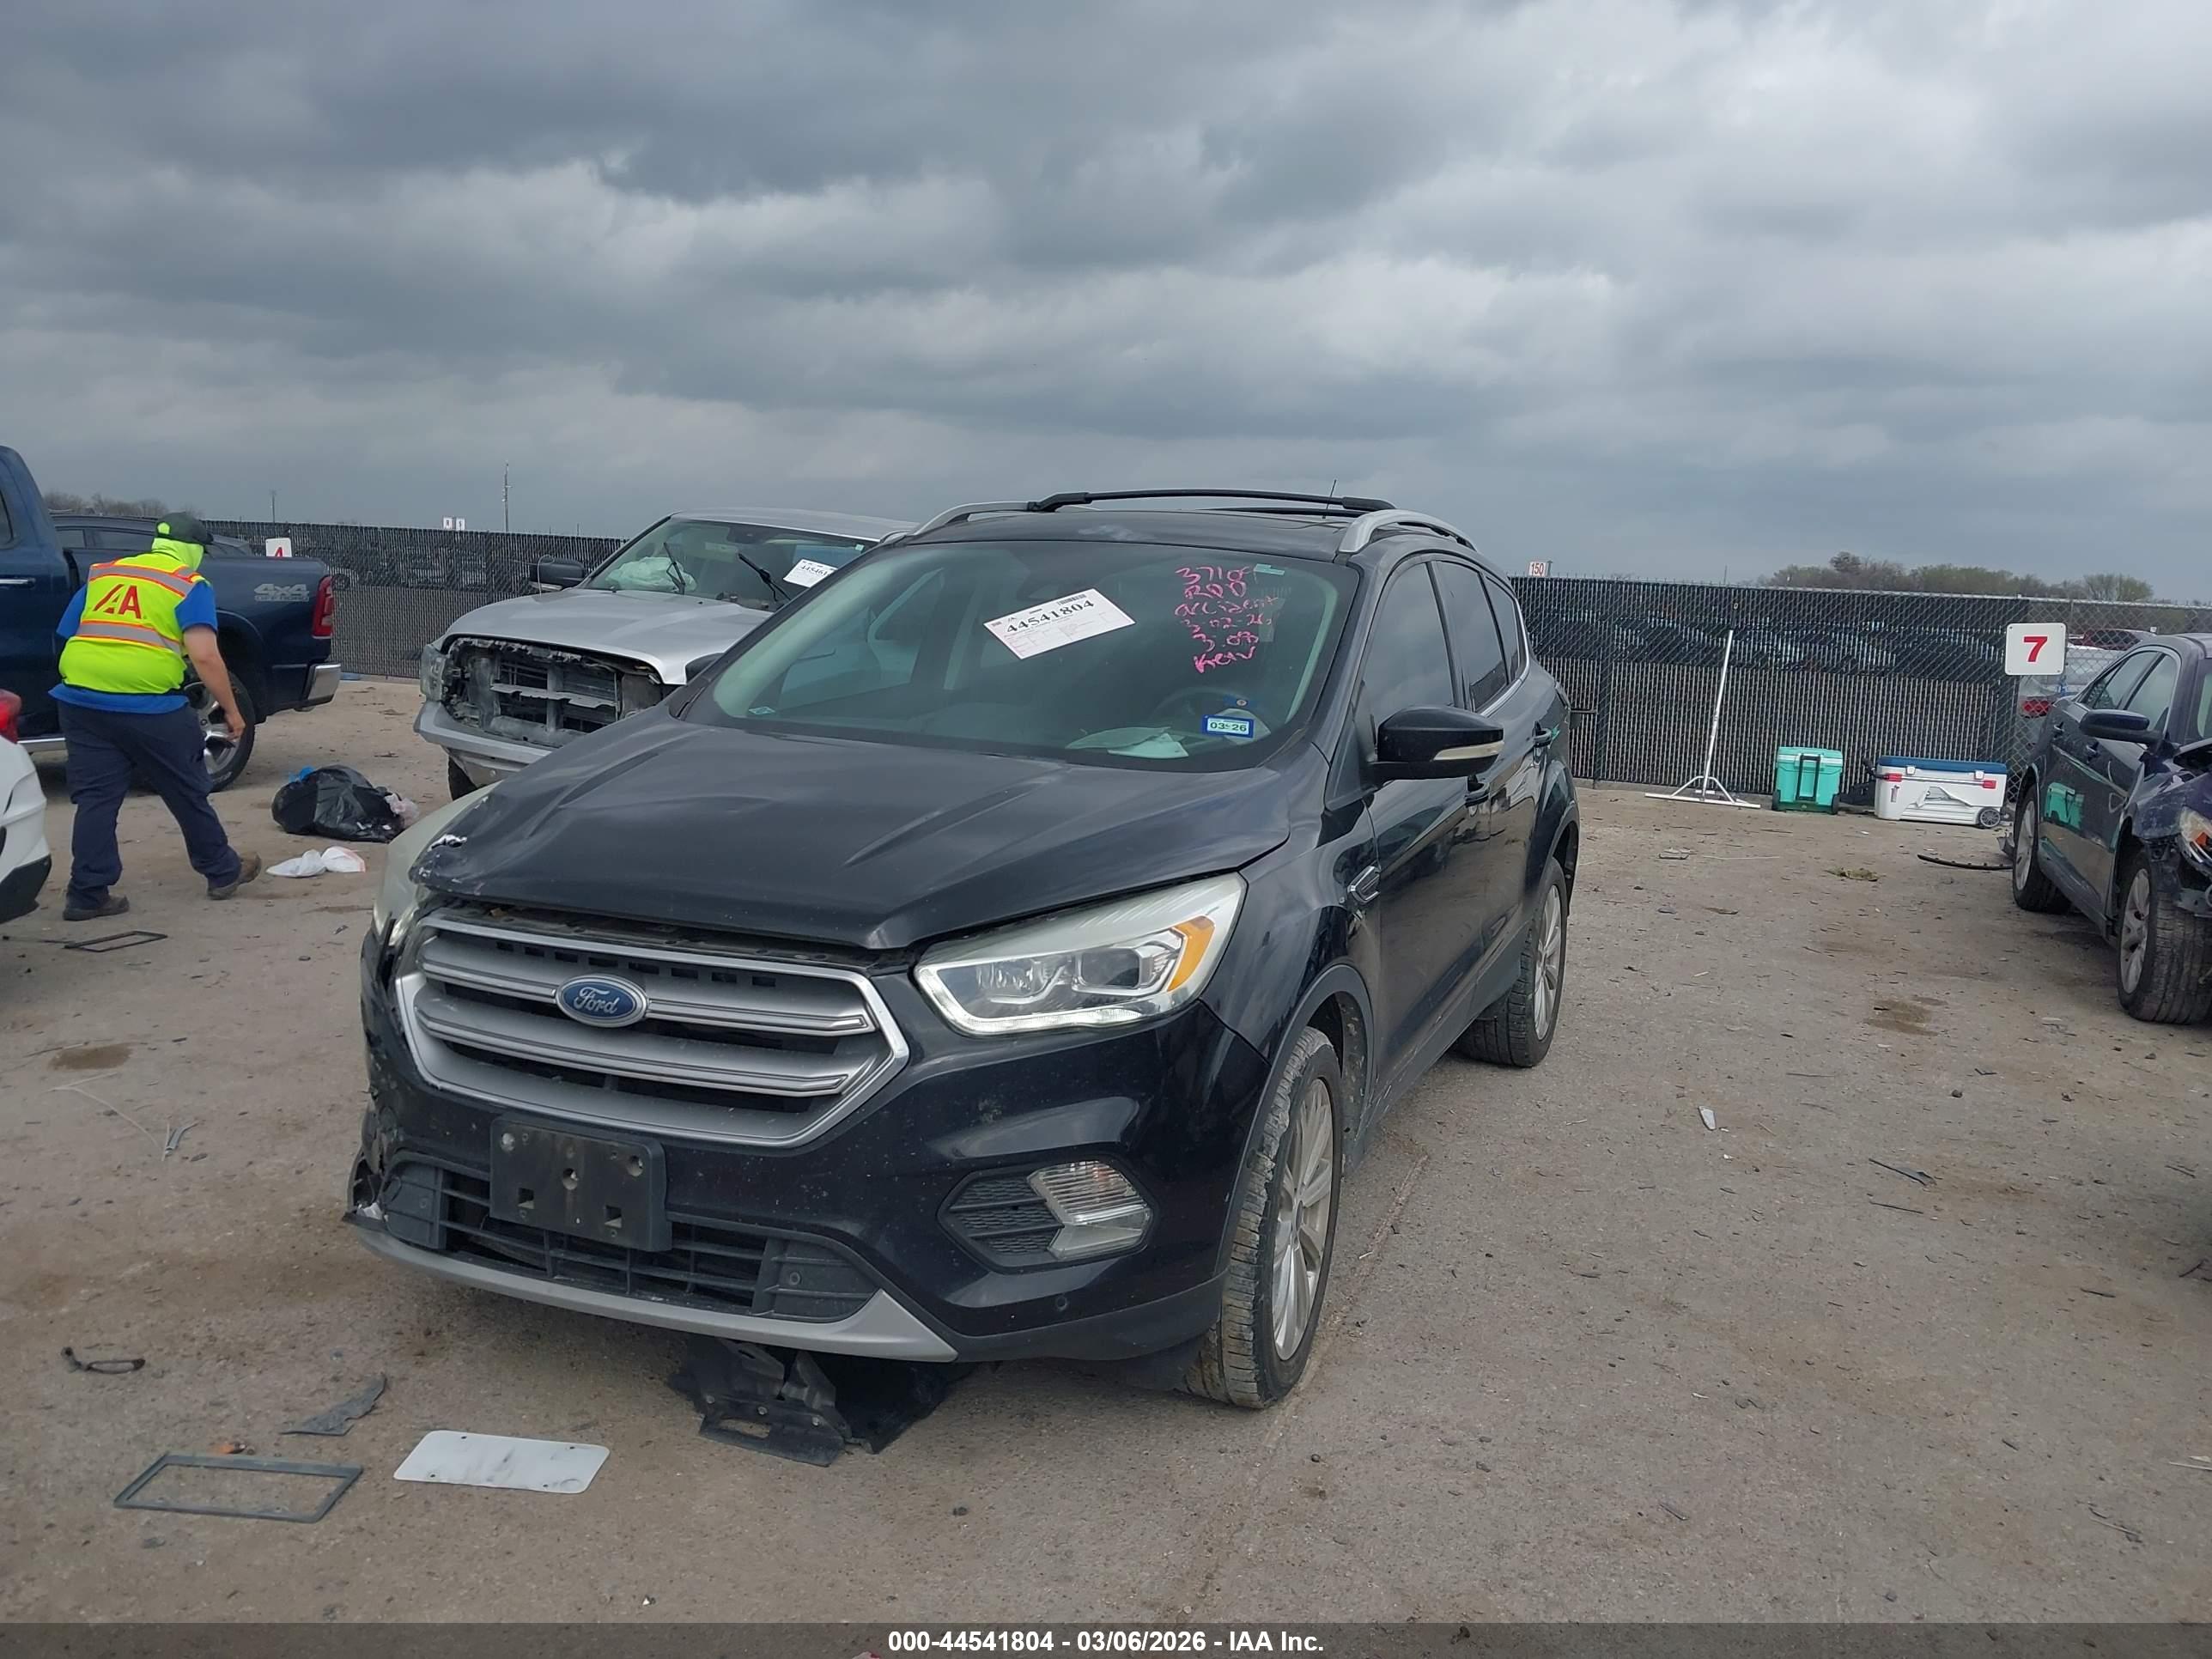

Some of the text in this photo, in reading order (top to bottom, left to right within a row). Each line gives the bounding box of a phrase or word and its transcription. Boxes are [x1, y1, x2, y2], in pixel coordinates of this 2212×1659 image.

[1531, 562, 1545, 574] 150
[1006, 599, 1096, 634] 44541804
[2023, 635, 2048, 663] 7
[574, 987, 620, 1014] Ford
